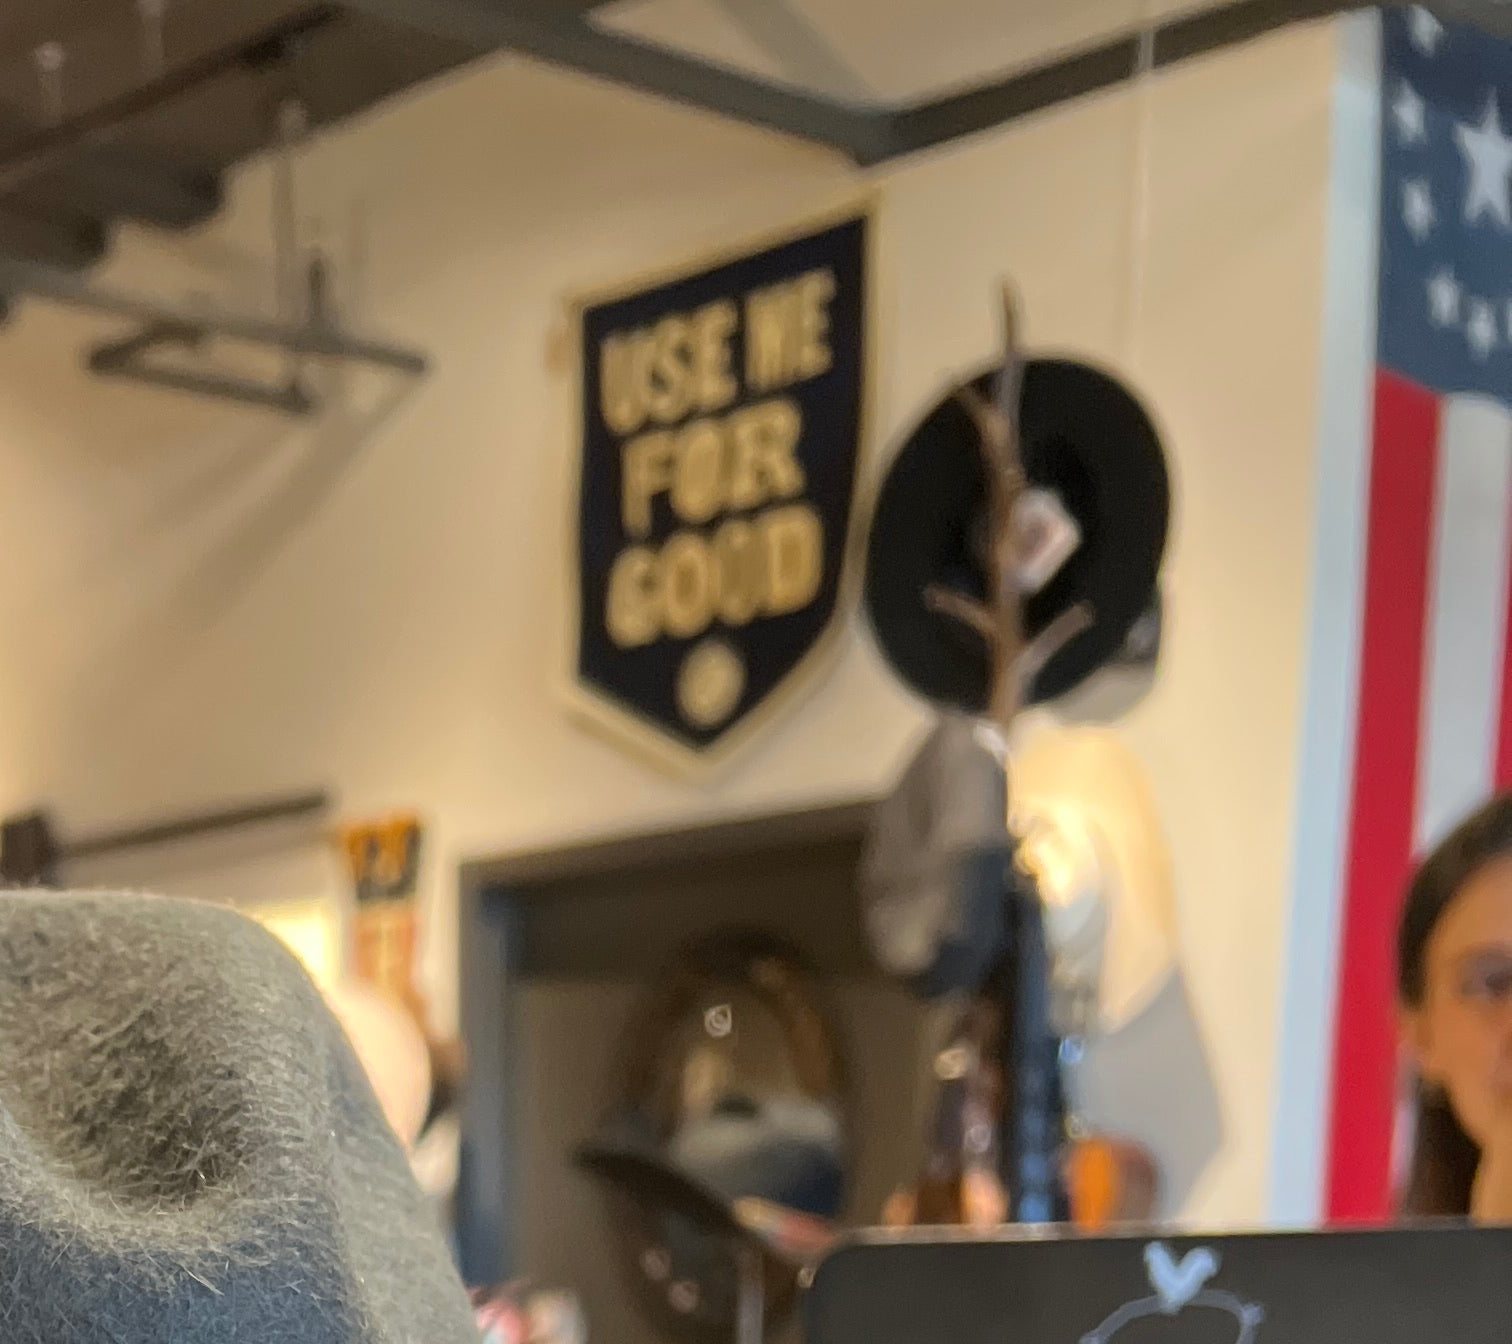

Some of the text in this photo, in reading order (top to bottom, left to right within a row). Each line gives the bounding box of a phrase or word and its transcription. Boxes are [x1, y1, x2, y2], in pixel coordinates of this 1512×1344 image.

[601, 268, 836, 433] USE ME
[621, 400, 805, 537] FOR
[607, 504, 823, 649] GOOD
